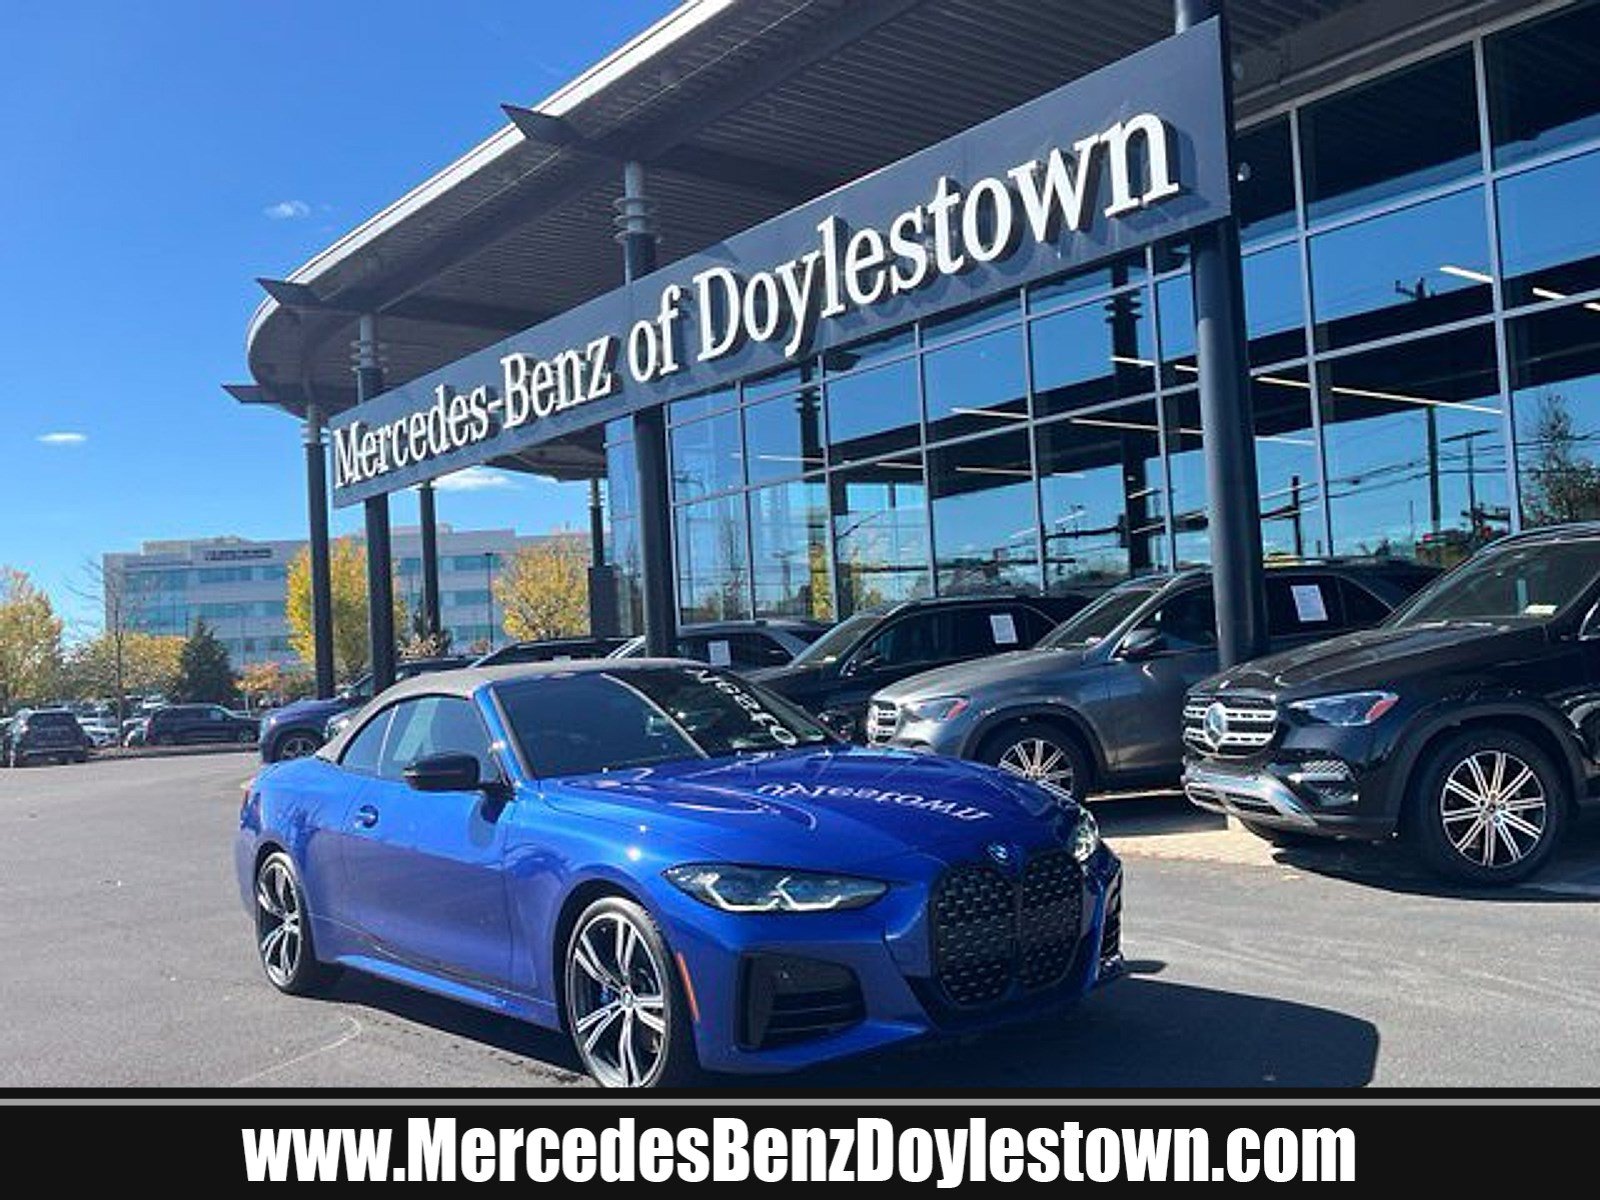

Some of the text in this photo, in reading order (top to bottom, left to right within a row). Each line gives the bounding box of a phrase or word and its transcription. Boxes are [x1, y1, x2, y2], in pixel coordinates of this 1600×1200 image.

[333, 112, 1180, 489] Mercedes-Benz of Doylestown
